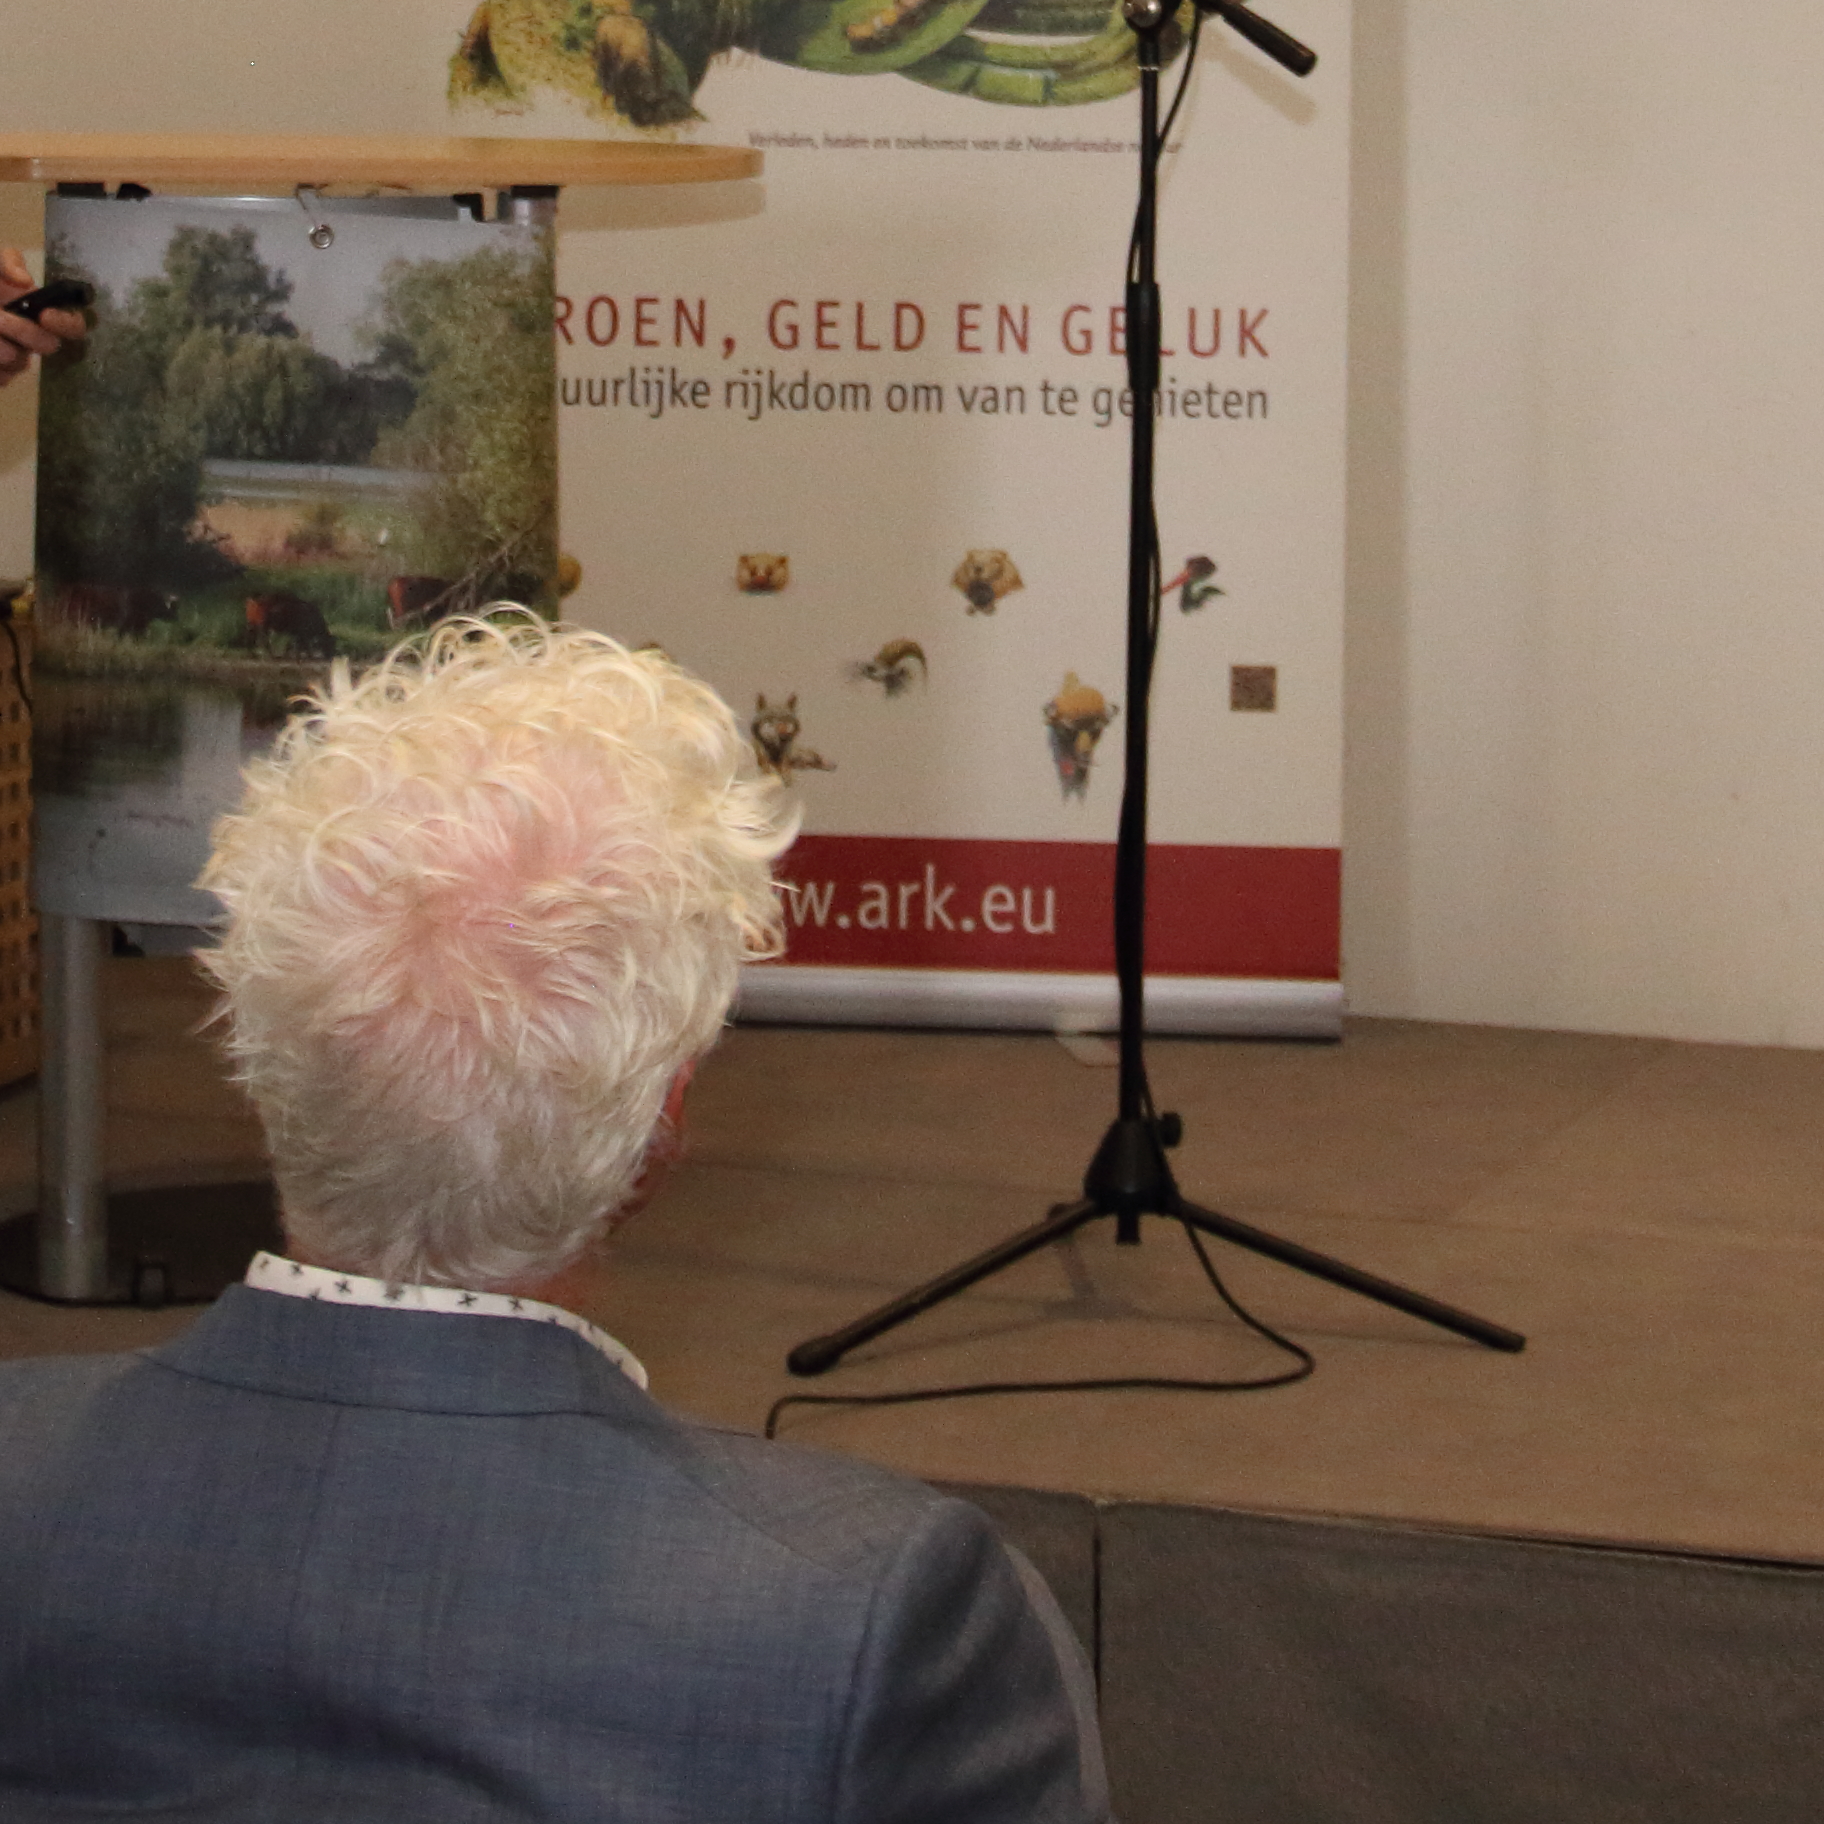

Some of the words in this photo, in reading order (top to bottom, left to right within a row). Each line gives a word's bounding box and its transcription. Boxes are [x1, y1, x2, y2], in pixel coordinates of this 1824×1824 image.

[555, 294, 737, 361] ROEN,
[768, 298, 926, 353] GELD
[956, 302, 1030, 355] EN
[561, 365, 712, 419] uurlijke
[726, 368, 872, 421] rijkdom
[886, 379, 944, 413] om
[958, 382, 1026, 415] van
[1040, 379, 1079, 417] te
[779, 862, 1057, 934] w.ark.eu
